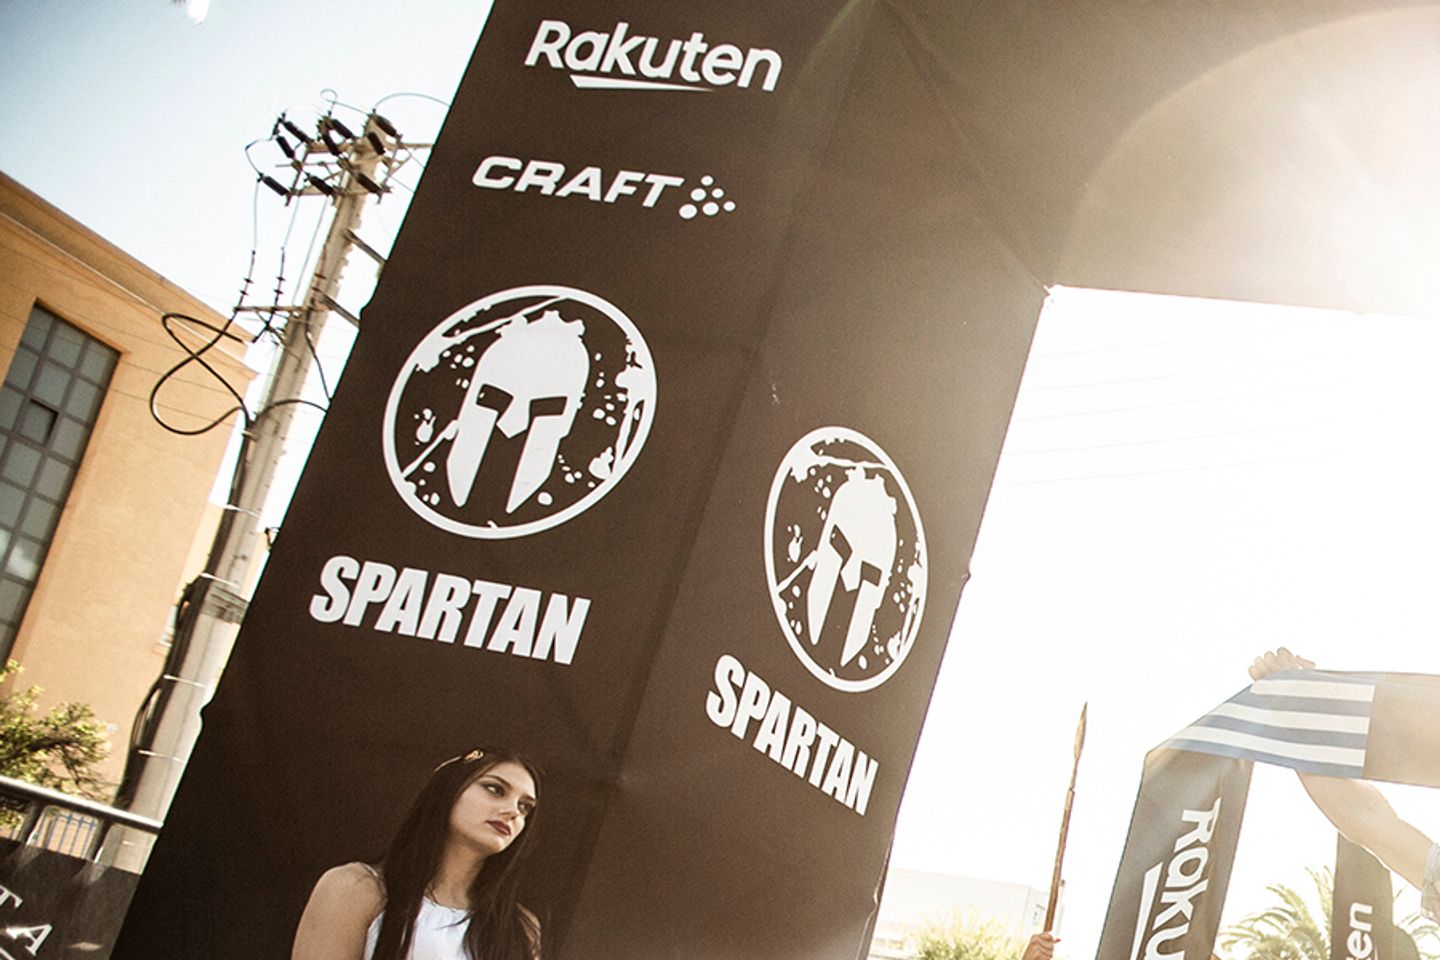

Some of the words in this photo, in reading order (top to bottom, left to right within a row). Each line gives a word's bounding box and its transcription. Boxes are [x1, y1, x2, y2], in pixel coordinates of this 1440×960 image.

[525, 20, 783, 92] Rakuten
[472, 156, 685, 208] CRAFT
[309, 555, 592, 665] SPARTAN
[706, 654, 879, 816] SPARTAN
